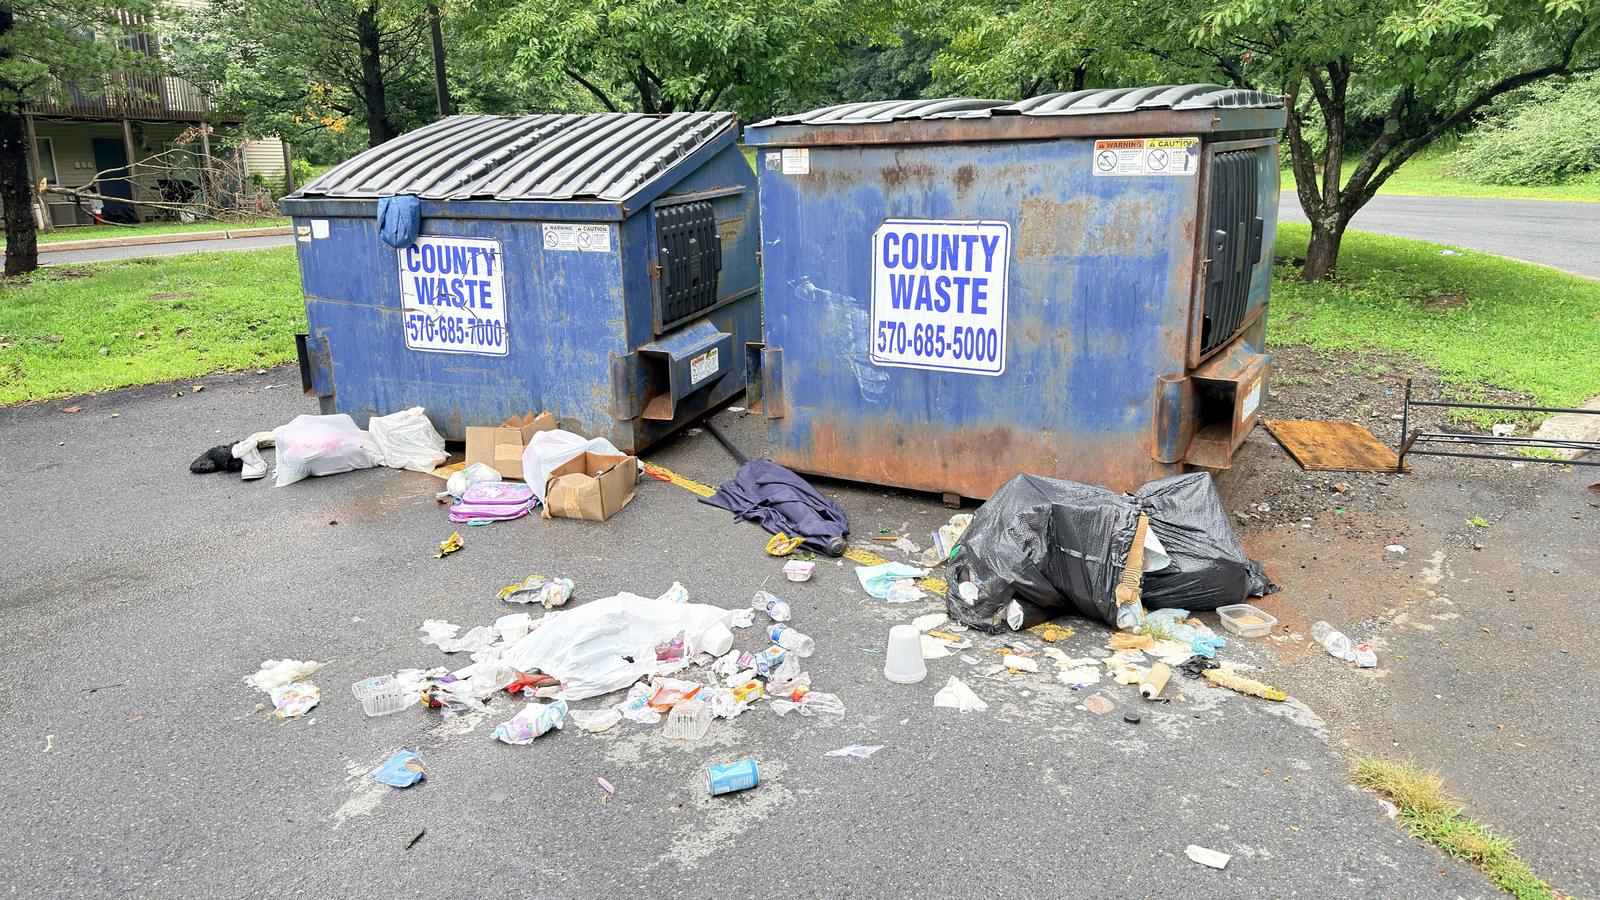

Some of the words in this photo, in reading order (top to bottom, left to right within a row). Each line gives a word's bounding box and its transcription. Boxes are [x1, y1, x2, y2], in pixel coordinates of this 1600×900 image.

[1107, 141, 1142, 149] WARNING
[1158, 140, 1196, 148] CAUTION
[406, 243, 496, 277] COUNTY
[883, 232, 1000, 273] COUNTY
[414, 276, 493, 310] WASTE
[889, 273, 988, 315] WASTE
[410, 314, 502, 347] 570-685-7000
[877, 320, 998, 362] 570-685-5000
